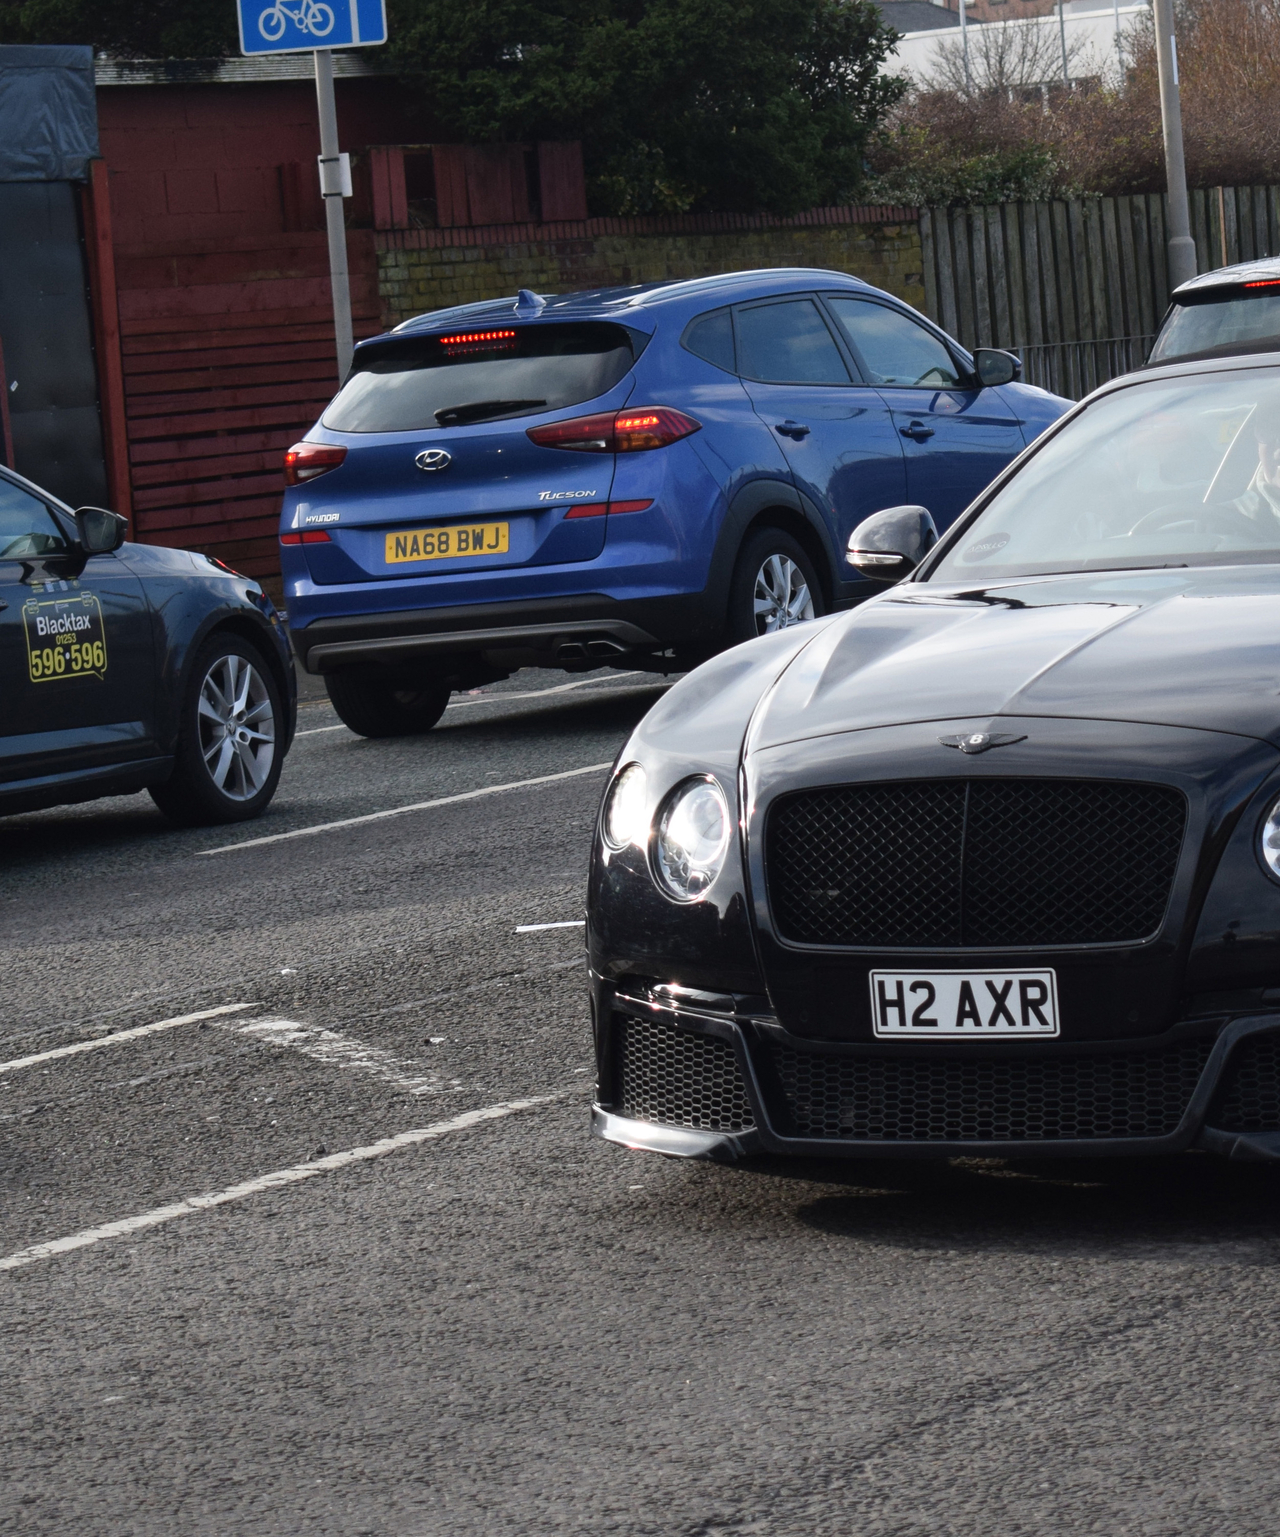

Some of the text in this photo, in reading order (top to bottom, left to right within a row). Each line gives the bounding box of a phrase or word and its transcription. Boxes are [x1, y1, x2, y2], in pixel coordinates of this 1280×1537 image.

[537, 489, 597, 501] TUCSON
[305, 513, 340, 524] HYUNDAI
[394, 526, 500, 559] NA68 BWJ
[36, 612, 92, 636] Blacktax
[55, 632, 77, 645] 01253
[969, 734, 984, 744] B
[877, 978, 1050, 1027] H2 AXR
